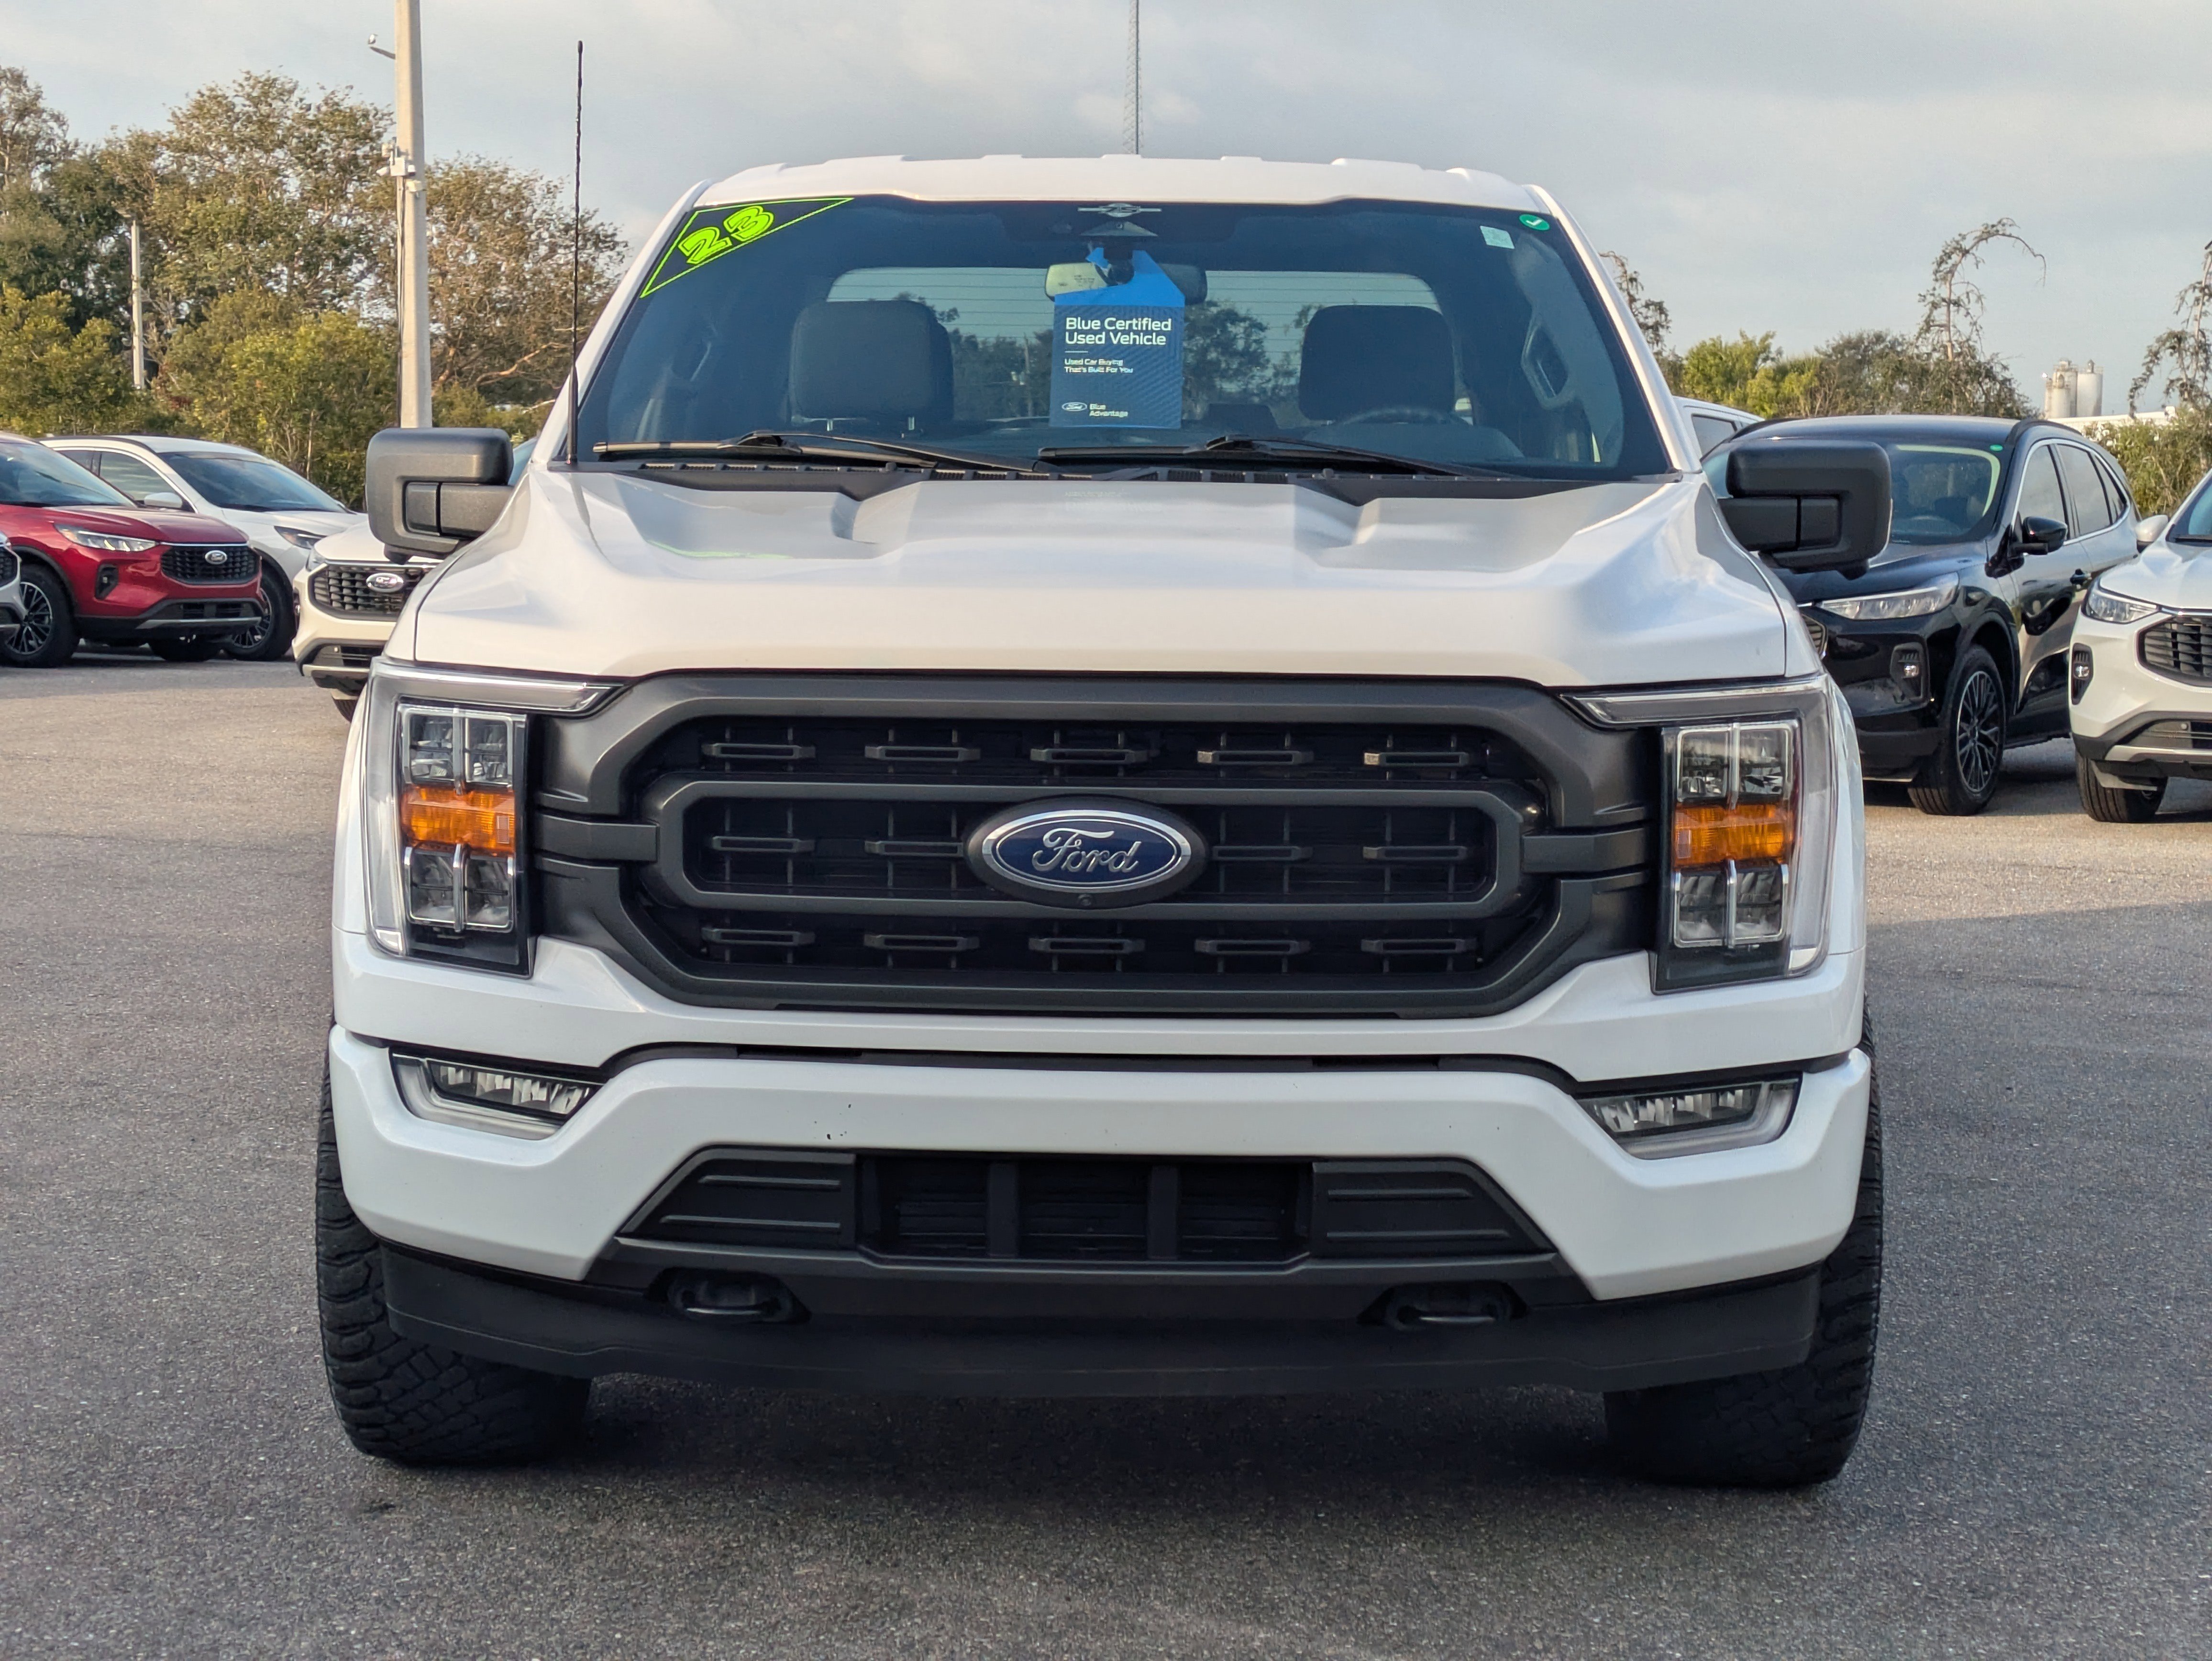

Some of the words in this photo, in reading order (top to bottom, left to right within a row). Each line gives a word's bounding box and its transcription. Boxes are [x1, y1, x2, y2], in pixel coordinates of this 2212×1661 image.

[678, 205, 775, 265] 23
[1065, 332, 1106, 344] Used
[1109, 332, 1166, 345] Vehicle
[1066, 317, 1101, 330] Blue
[1104, 317, 1172, 331] Certified
[1032, 828, 1142, 873] Ford
